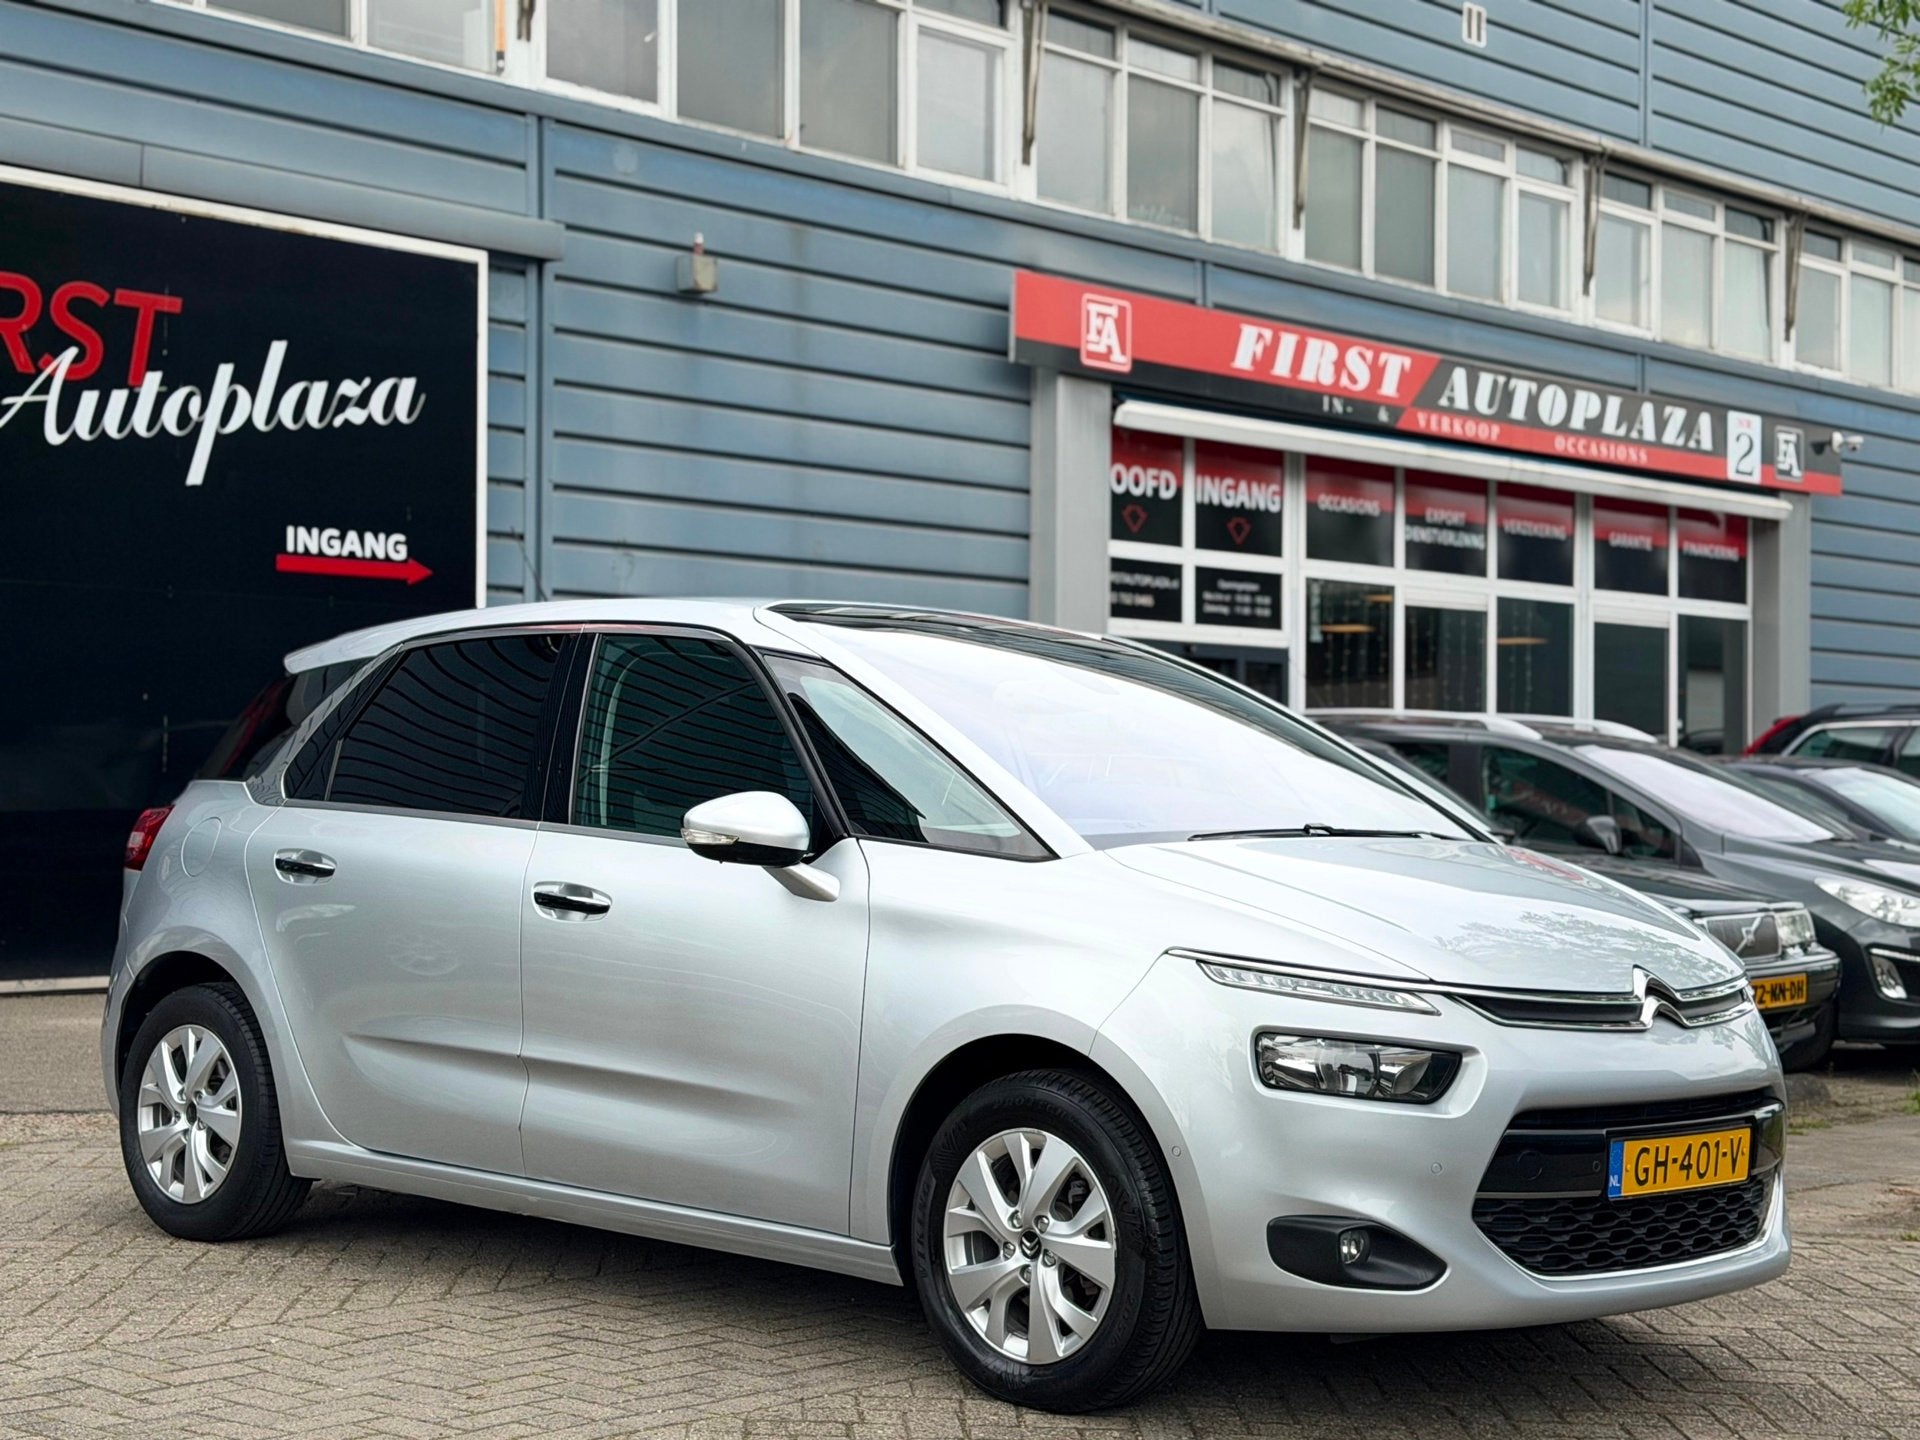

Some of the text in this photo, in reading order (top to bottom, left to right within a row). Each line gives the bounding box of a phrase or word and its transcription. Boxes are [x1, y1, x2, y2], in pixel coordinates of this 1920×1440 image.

[0, 271, 183, 387] RST
[1230, 323, 1714, 451] FIRST AUTOPLAZA
[0, 340, 426, 486] Autoplaza
[1377, 405, 1390, 422] &
[1417, 411, 1501, 441] VERKOOP
[1554, 435, 1649, 465] OCCASIONS
[1735, 432, 1754, 476] 2
[1196, 474, 1282, 513] INGANG
[286, 526, 408, 561] INGANG
[1609, 1175, 1621, 1187] NL
[1634, 1136, 1743, 1187] GH-401-V
